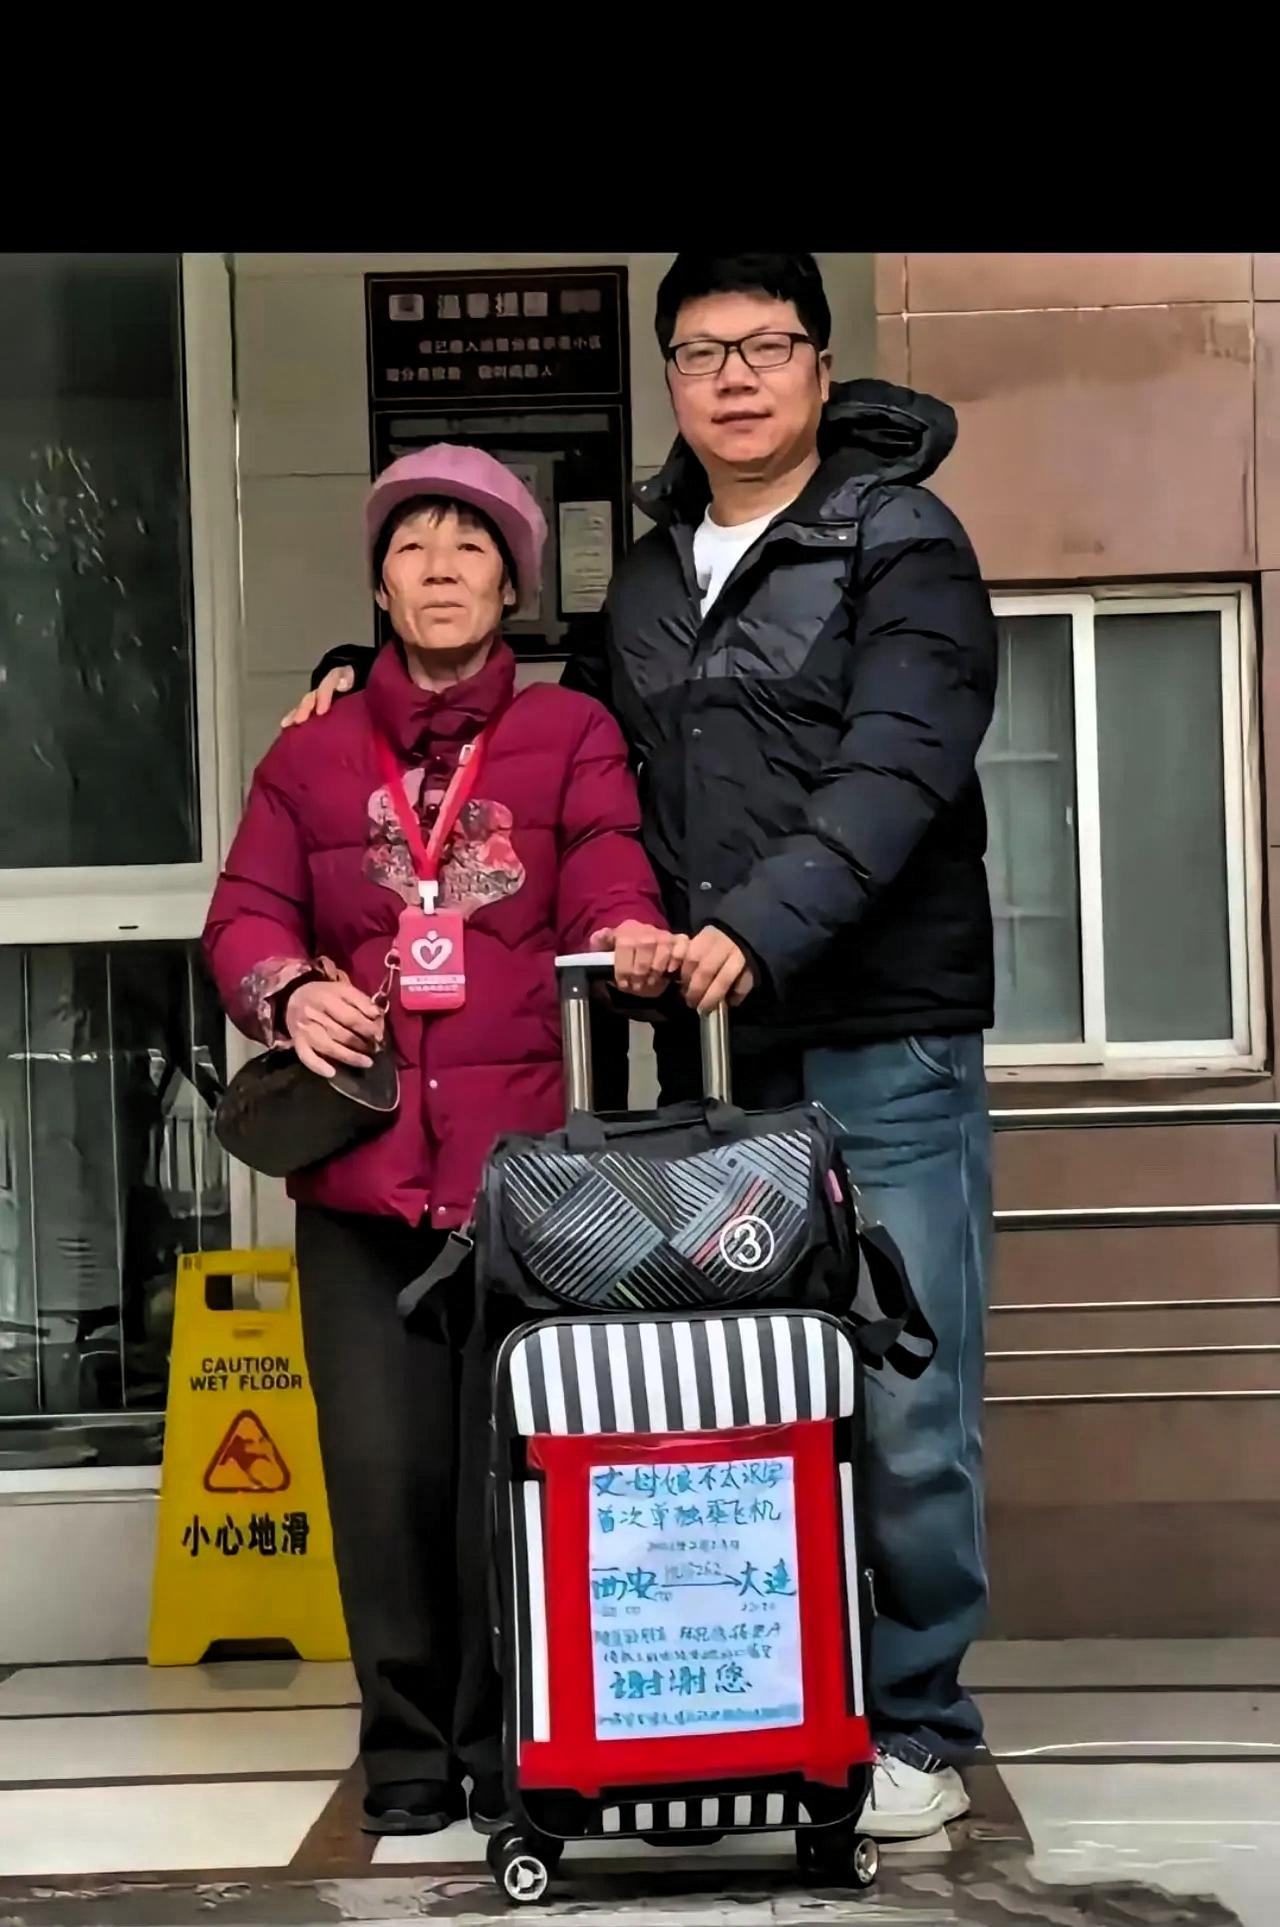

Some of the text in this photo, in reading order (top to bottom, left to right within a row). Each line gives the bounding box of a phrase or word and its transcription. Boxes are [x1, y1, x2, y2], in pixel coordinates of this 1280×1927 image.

[201, 1356, 290, 1374] CAUTION
[190, 1373, 302, 1392] WET FLOOR
[182, 1511, 309, 1557] 小心地滑
[609, 1662, 752, 1699] 谢谢您
